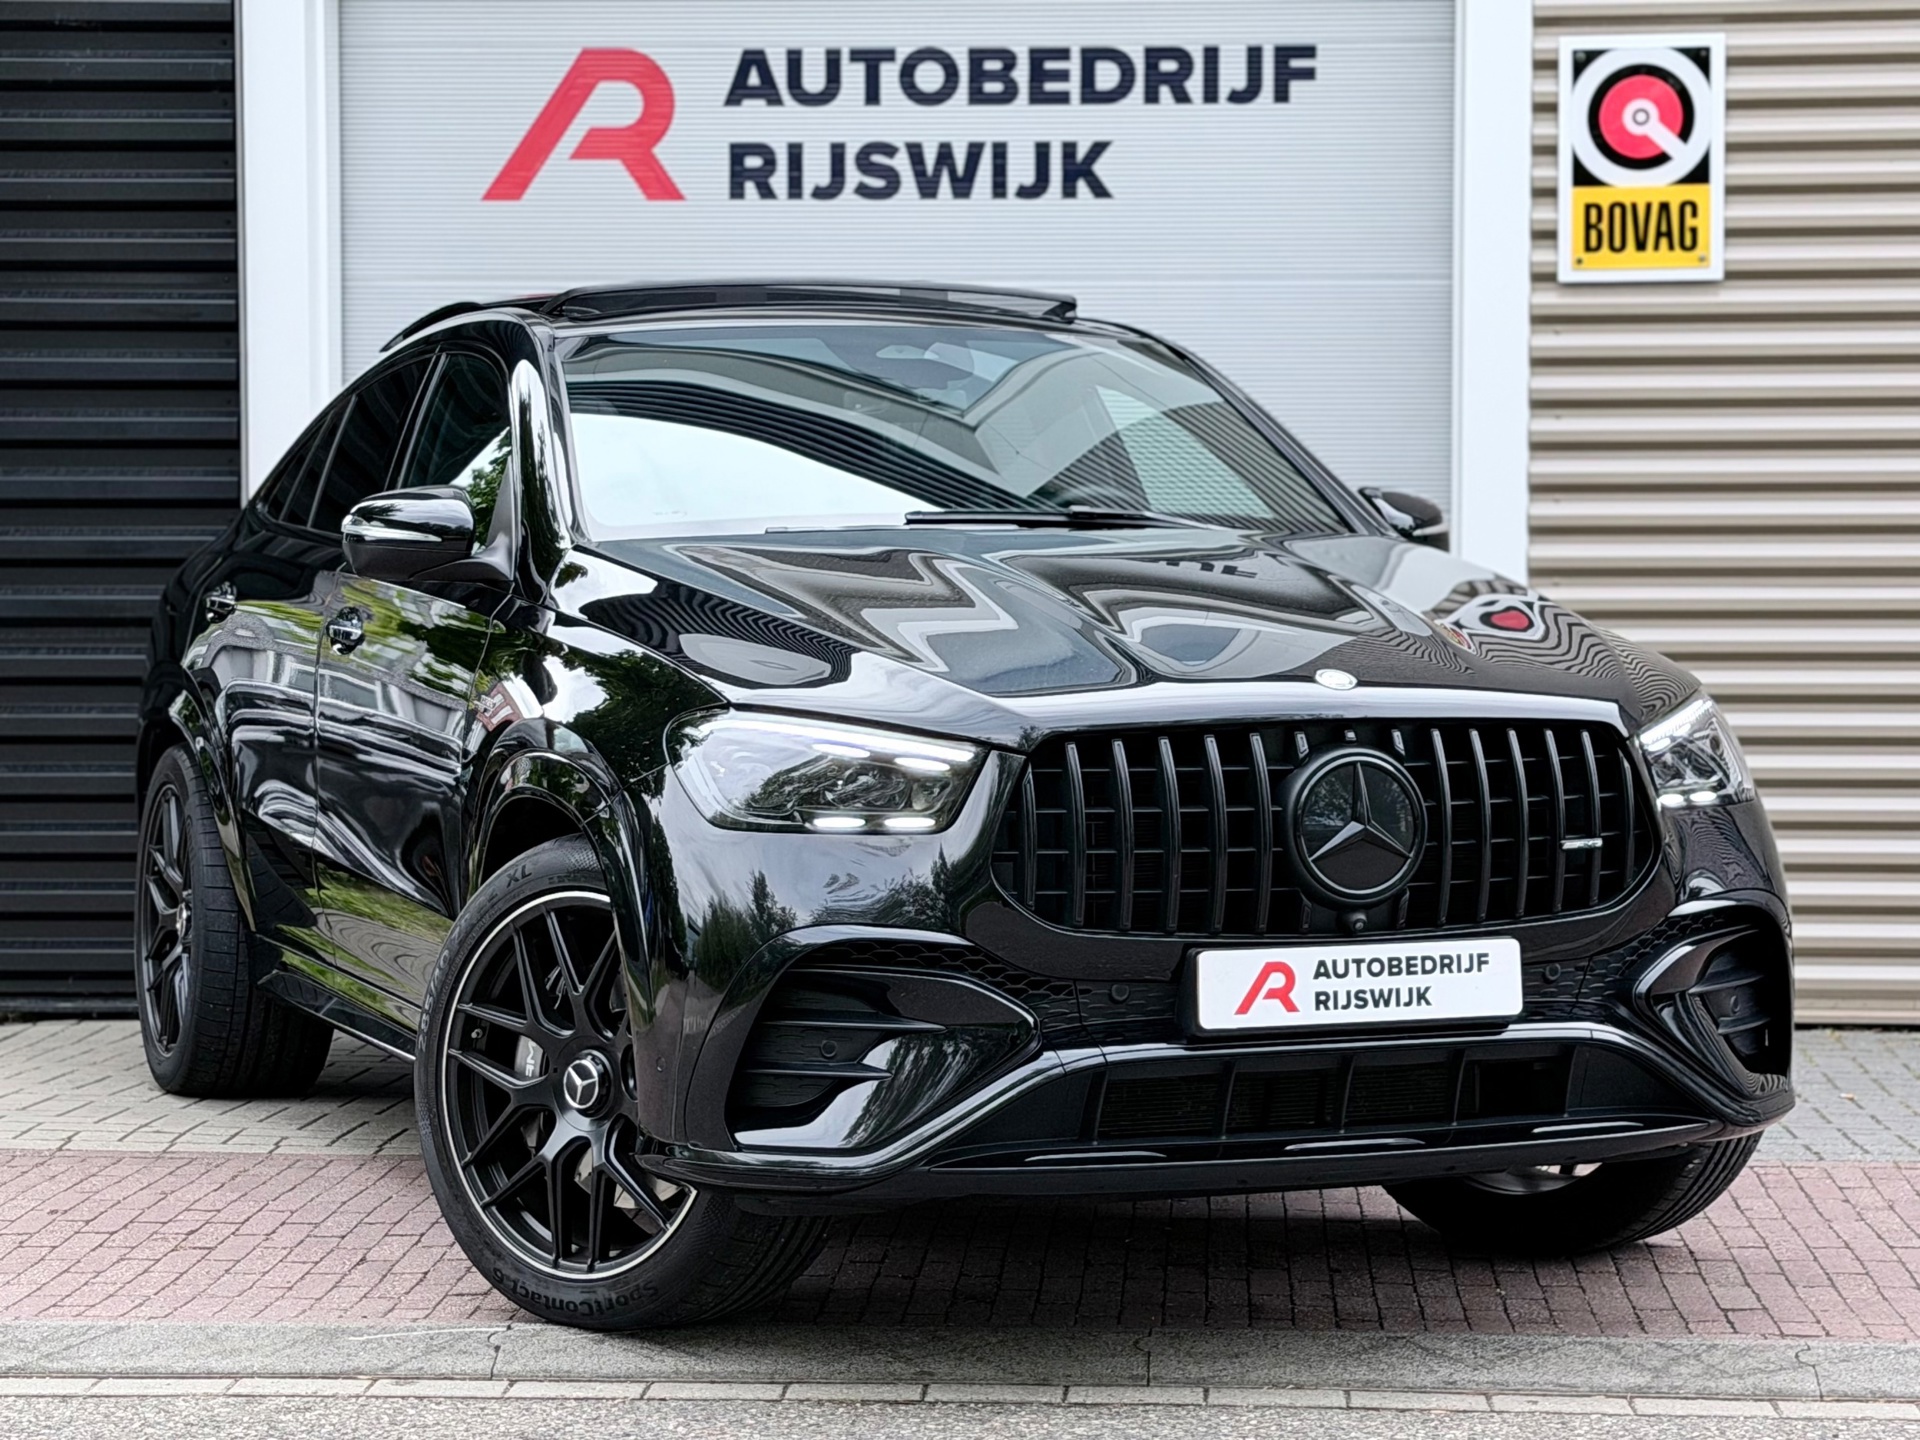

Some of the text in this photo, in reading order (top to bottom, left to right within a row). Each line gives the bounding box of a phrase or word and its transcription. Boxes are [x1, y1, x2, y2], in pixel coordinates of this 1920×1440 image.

[724, 45, 1318, 107] AUTOBEDRIJF
[728, 140, 1113, 201] RIJSWIJK
[1583, 200, 1699, 254] BOVAG
[505, 863, 533, 888] XL
[1312, 952, 1490, 981] AUTOBEDRIJF
[1314, 986, 1432, 1012] RIJSWIJK
[509, 1279, 658, 1316] SportContact
